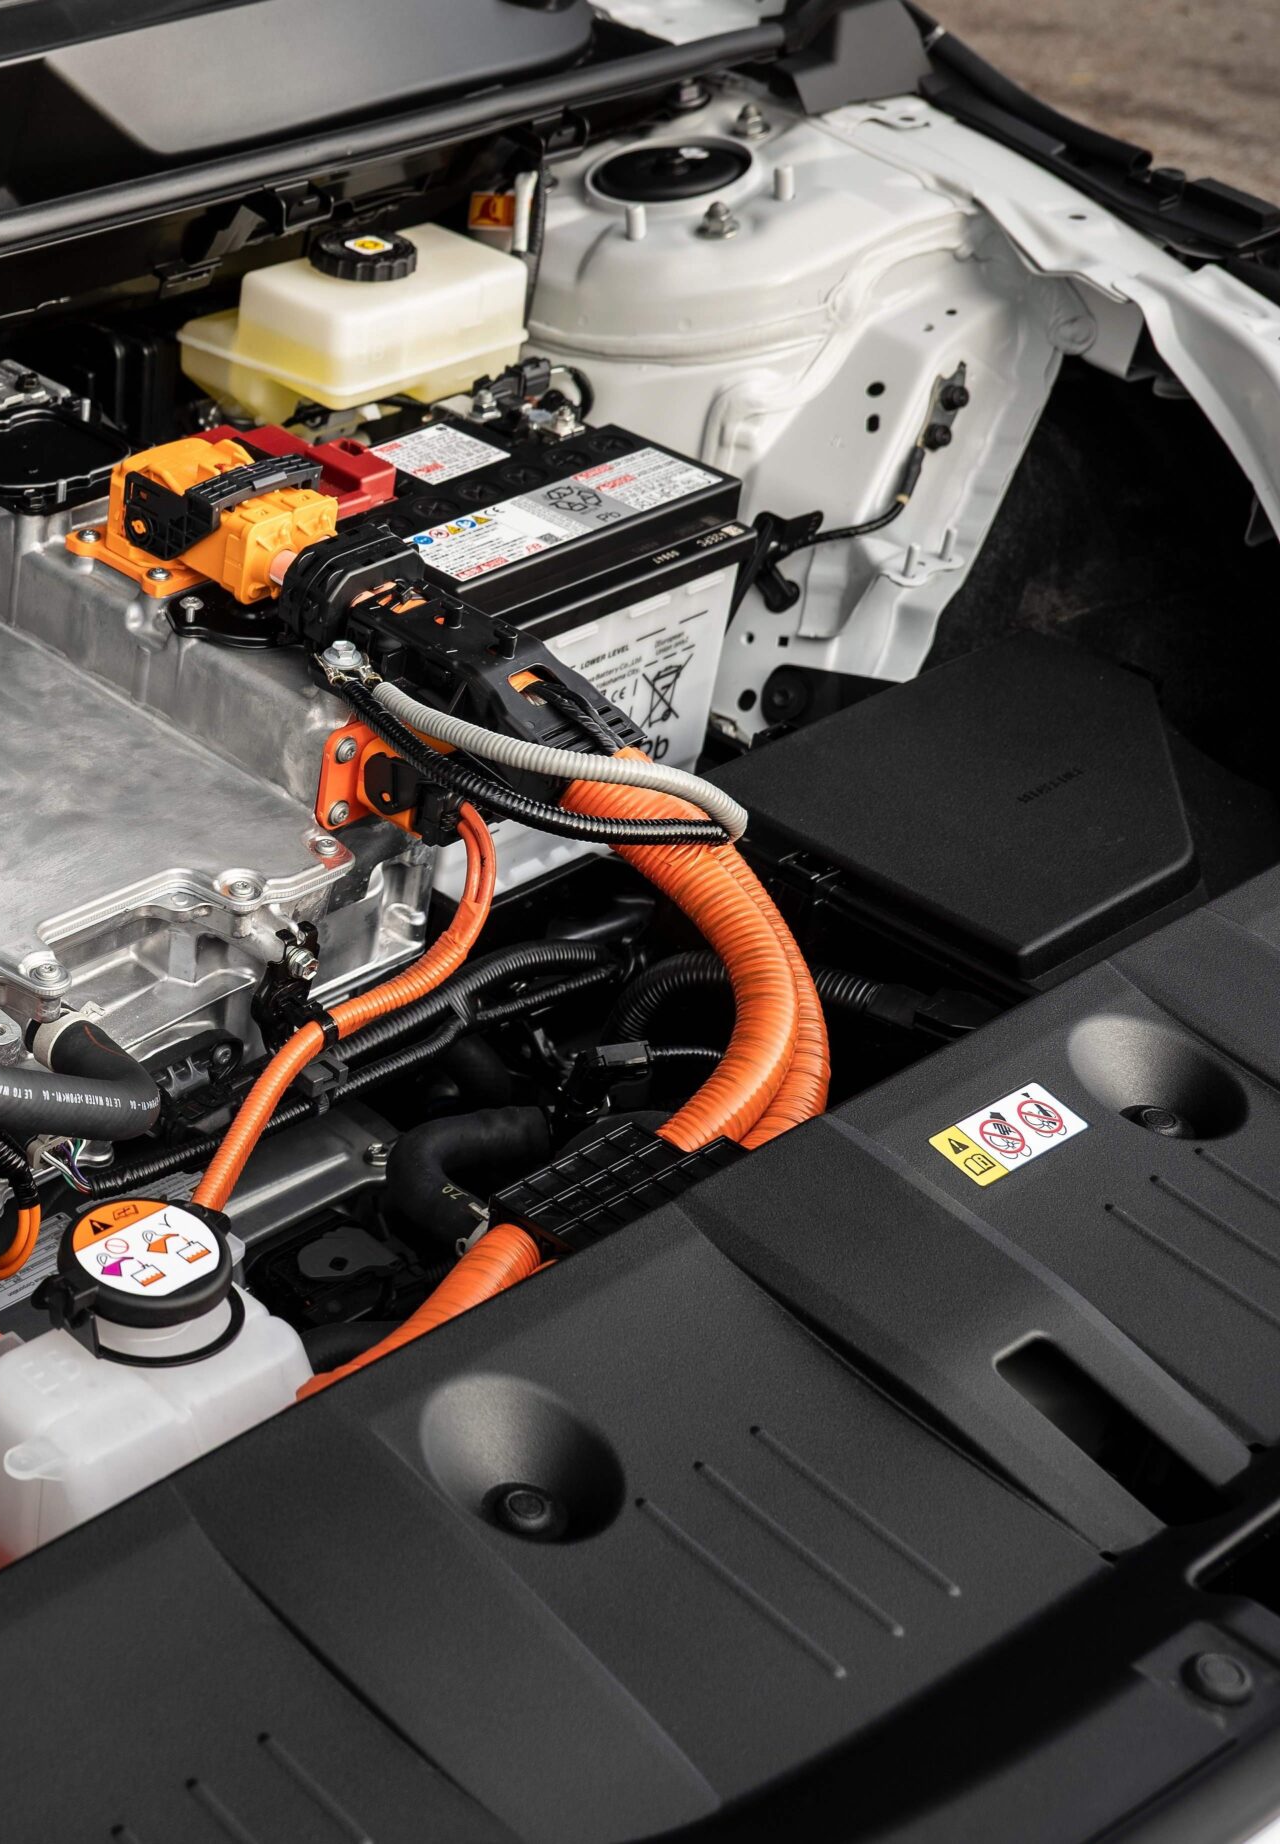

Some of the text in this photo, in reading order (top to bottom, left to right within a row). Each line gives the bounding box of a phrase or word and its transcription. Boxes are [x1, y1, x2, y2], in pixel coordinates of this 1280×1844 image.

[580, 644, 629, 670] LOWER LEVEL
[595, 667, 617, 680] Battery
[12, 1088, 23, 1098] TG
[22, 1089, 34, 1101] LE
[84, 1094, 103, 1106] WATER
[105, 1097, 113, 1107] TG
[112, 1098, 121, 1107] LE
